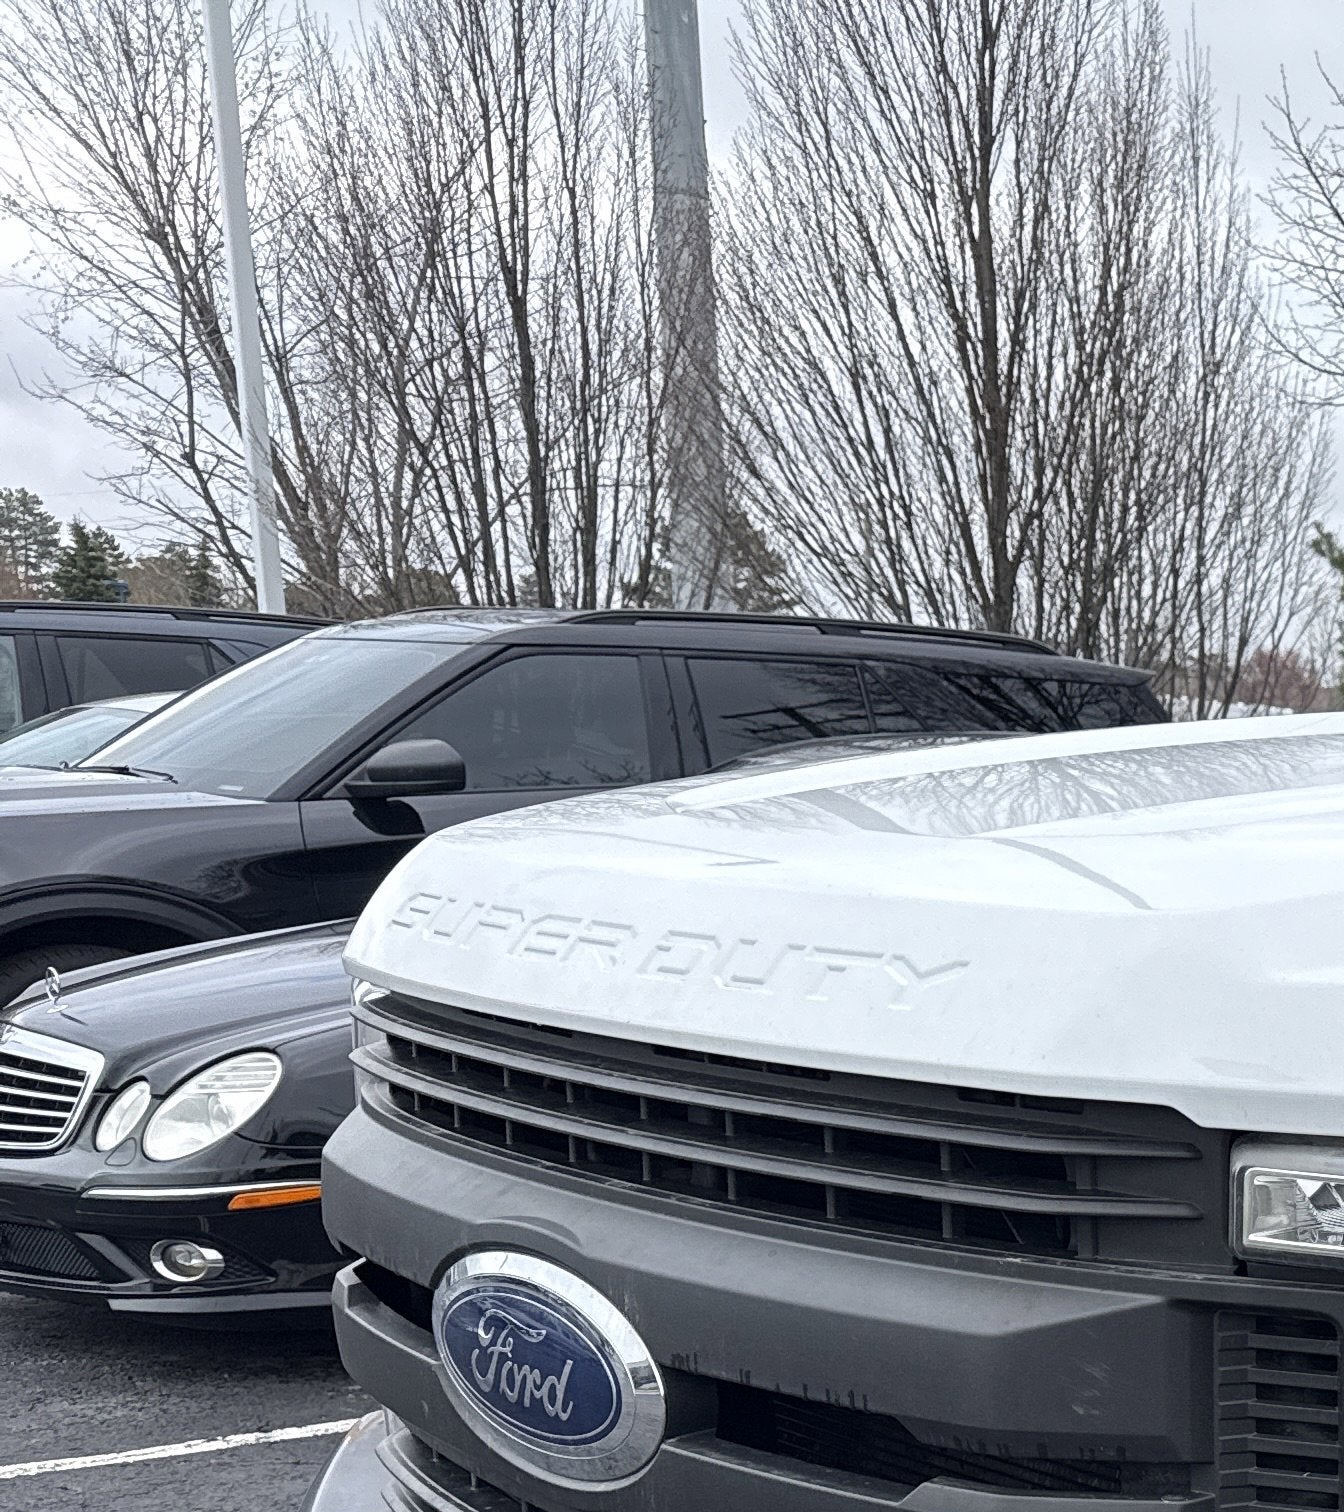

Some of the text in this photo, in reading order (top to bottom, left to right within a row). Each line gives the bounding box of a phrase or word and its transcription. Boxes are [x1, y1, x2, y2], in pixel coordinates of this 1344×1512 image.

[390, 891, 971, 1011] SUPER DUTY
[471, 1308, 574, 1421] Ford
